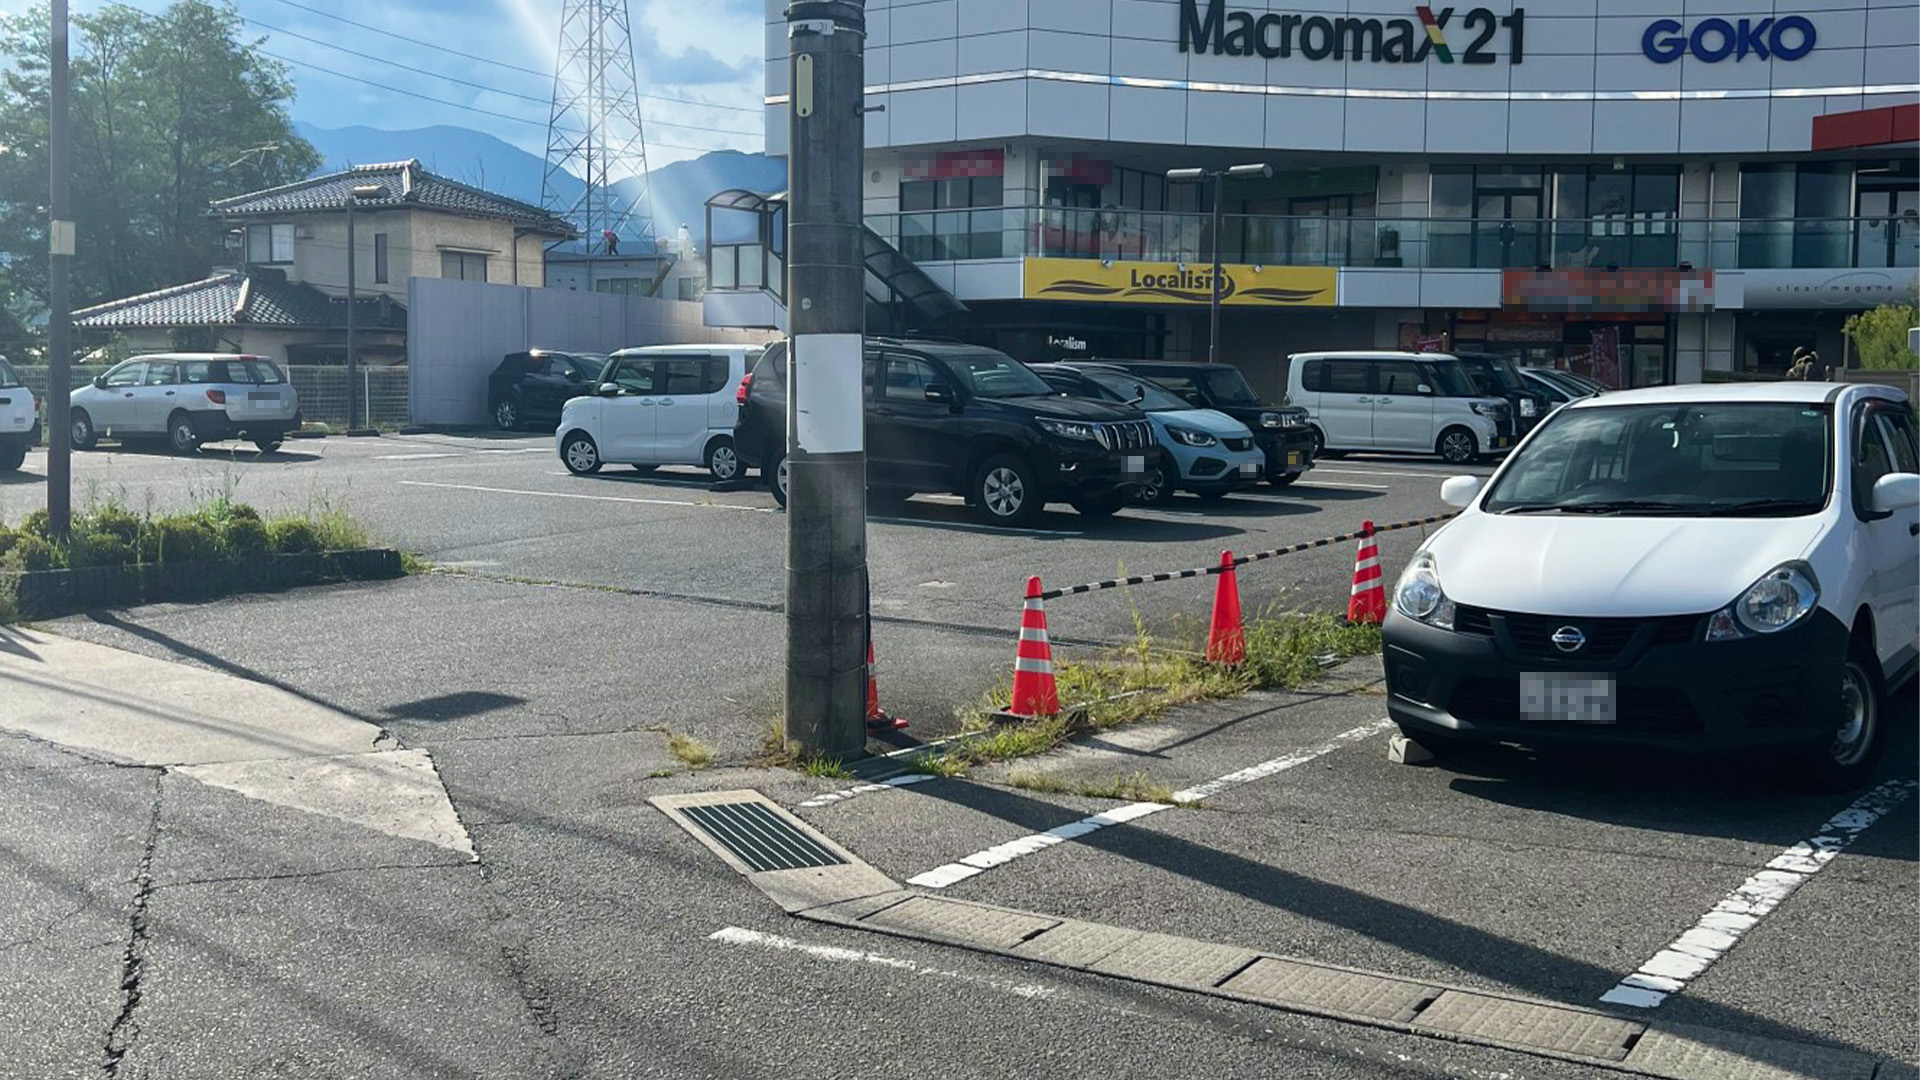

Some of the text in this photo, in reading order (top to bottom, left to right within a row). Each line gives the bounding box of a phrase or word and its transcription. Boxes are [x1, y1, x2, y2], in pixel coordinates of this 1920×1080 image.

[1178, 0, 1525, 64] MacromaX 21
[1642, 16, 1816, 64] GOKO
[1776, 284, 1893, 293] clear megane
